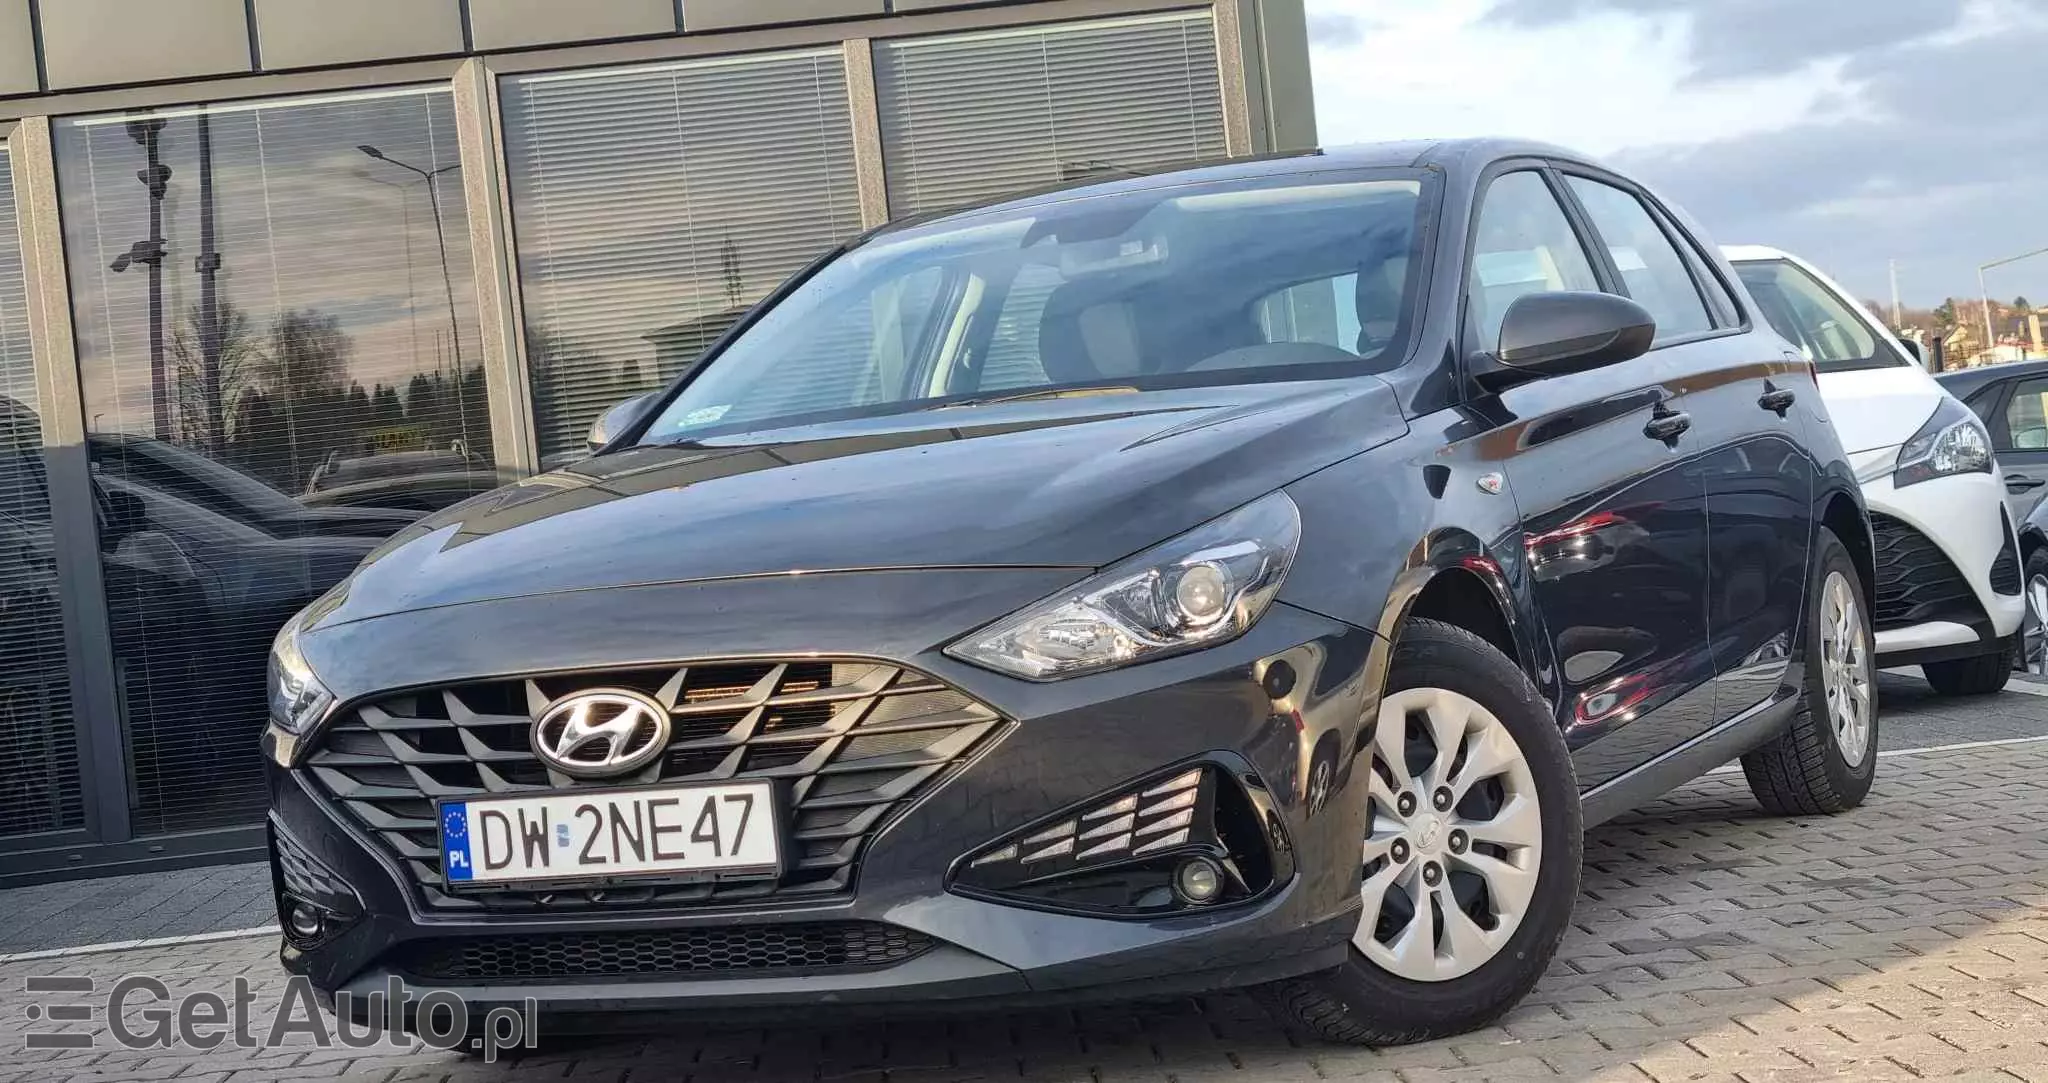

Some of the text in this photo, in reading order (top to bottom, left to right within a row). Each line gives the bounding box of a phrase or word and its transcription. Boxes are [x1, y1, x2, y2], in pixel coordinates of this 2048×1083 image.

[480, 793, 754, 870] DW 2NE47
[449, 851, 469, 868] PL
